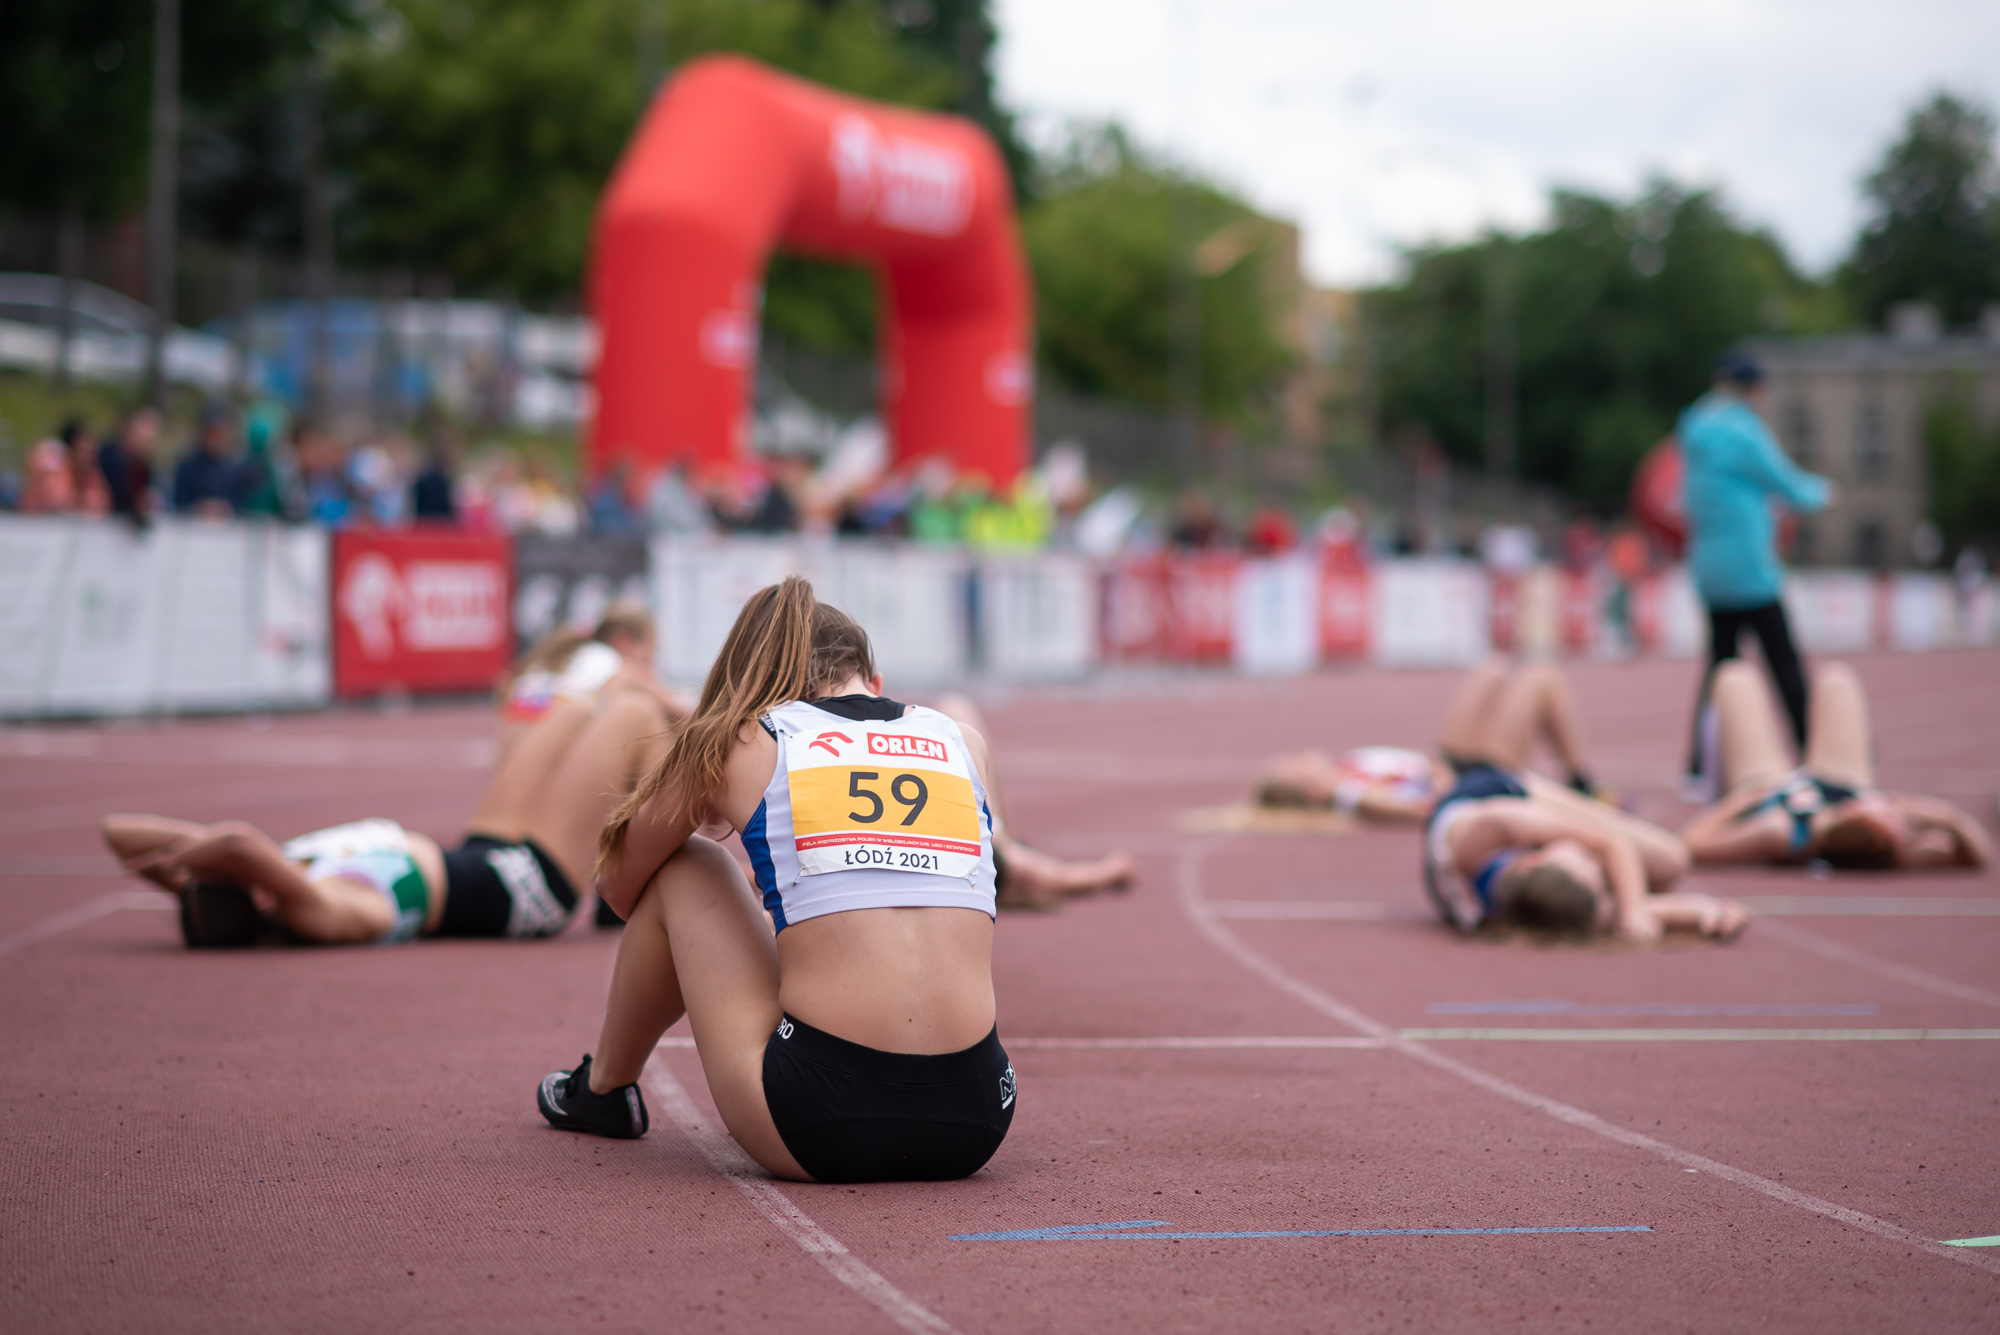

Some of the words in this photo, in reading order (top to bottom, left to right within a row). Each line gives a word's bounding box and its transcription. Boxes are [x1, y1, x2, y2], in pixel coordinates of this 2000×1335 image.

[871, 735, 945, 760] ORLEN
[848, 771, 929, 826] 59
[845, 845, 895, 866] ŁÓDŹ
[899, 852, 939, 870] 2021
